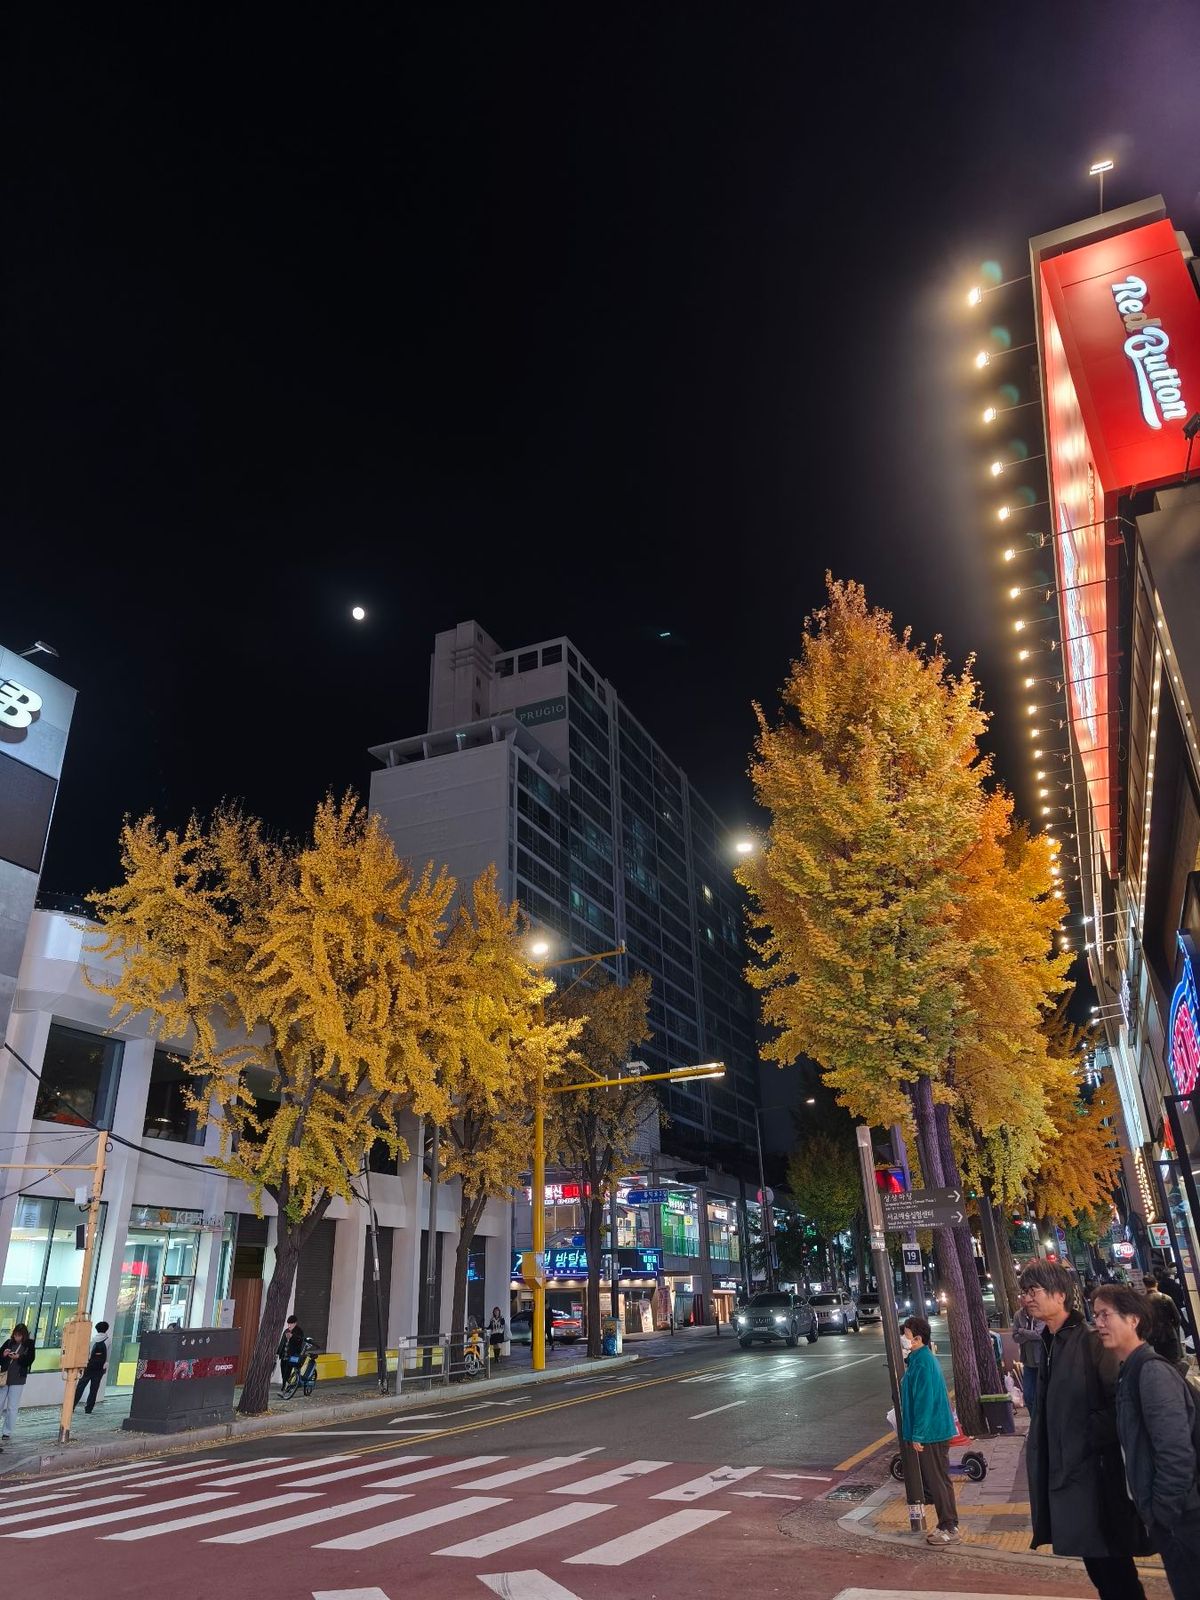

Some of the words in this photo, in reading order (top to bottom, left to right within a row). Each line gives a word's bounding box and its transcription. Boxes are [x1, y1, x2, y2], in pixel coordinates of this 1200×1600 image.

[1111, 276, 1162, 334] Red
[1123, 326, 1188, 430] Button
[520, 704, 564, 721] PRUGIO
[907, 1251, 917, 1261] 19
